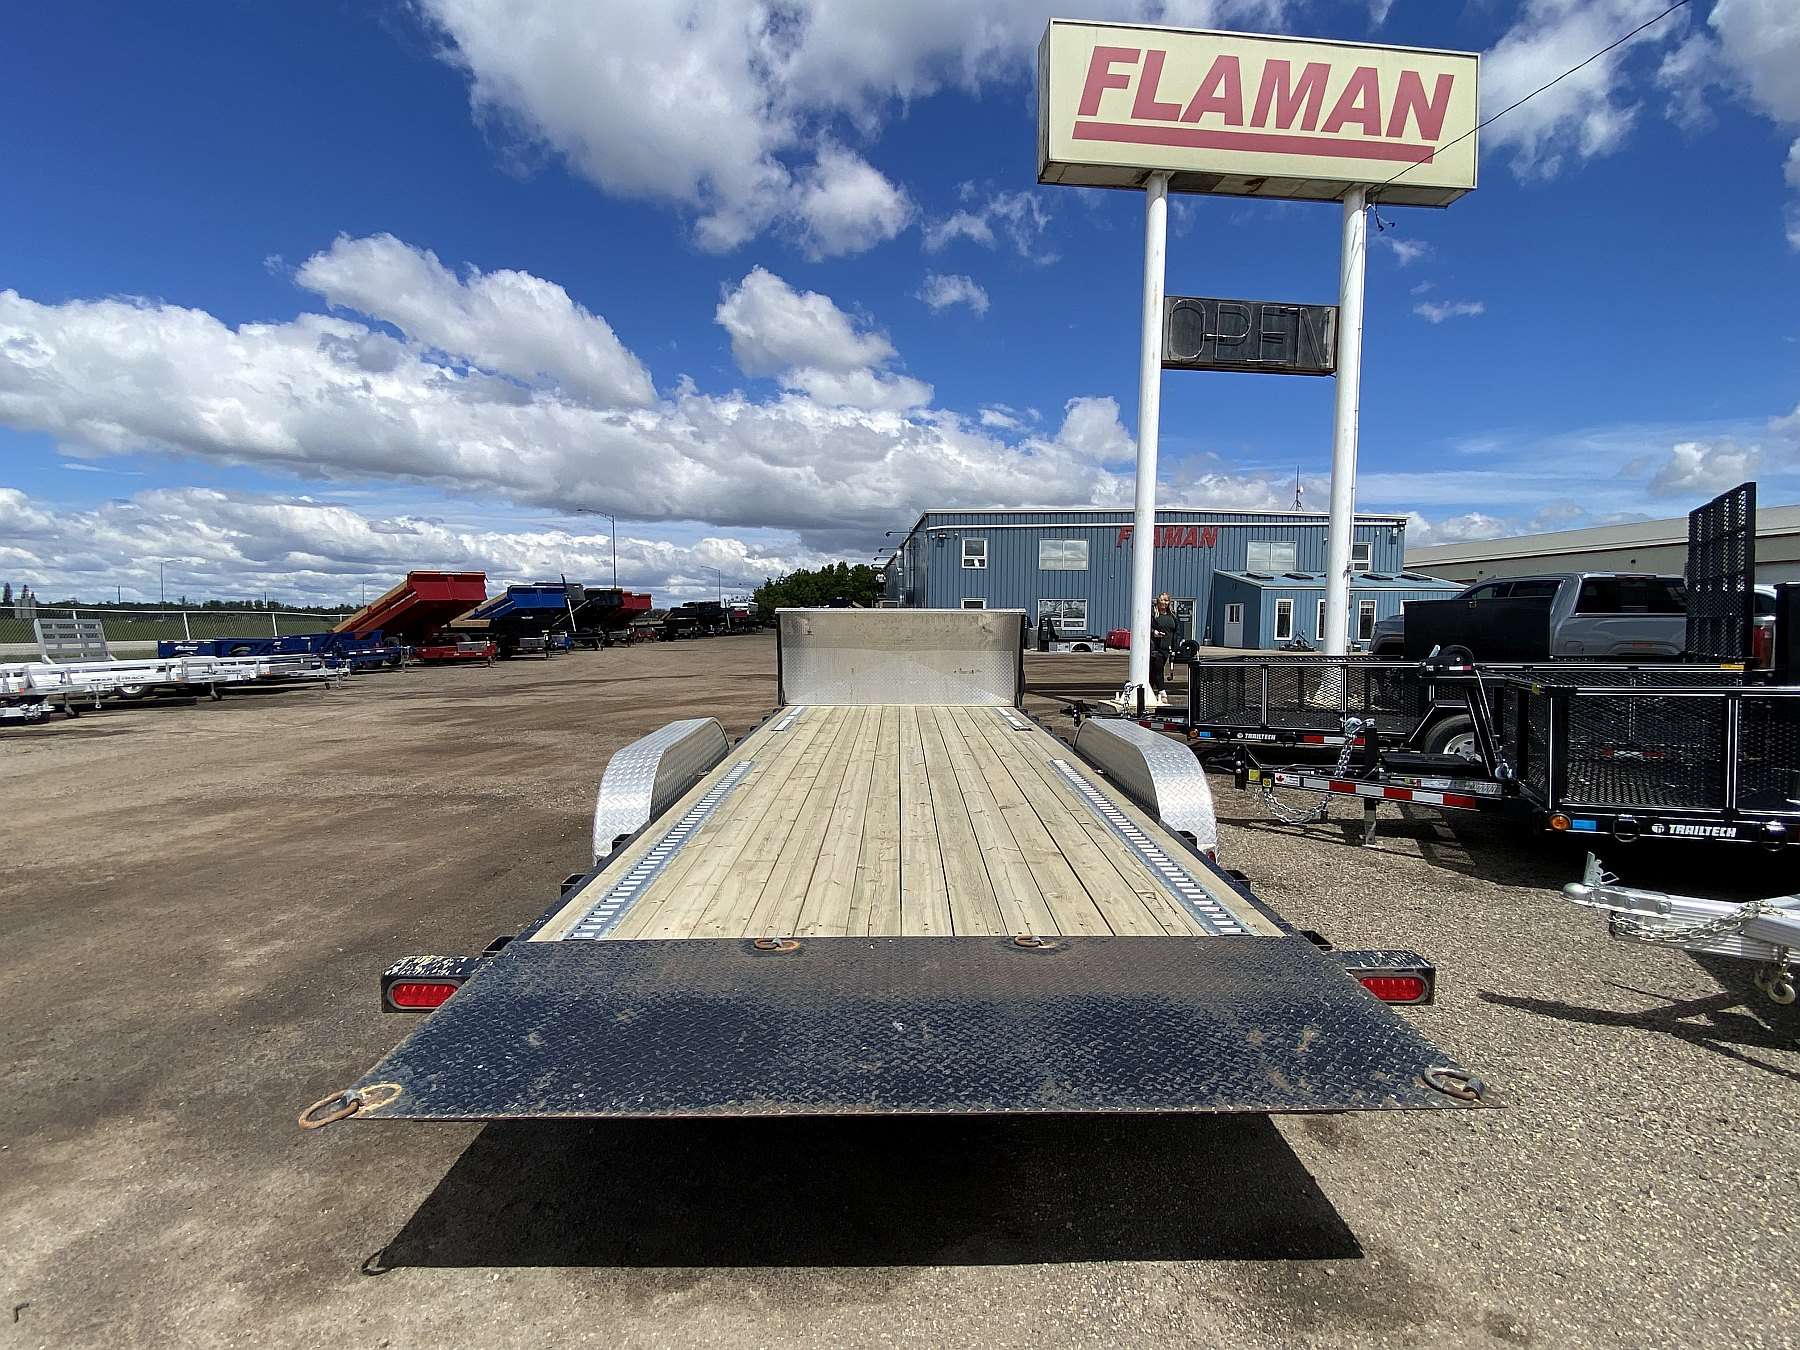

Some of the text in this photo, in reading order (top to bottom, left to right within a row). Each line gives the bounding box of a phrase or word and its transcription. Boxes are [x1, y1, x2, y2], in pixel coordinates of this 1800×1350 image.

[1077, 46, 1455, 141] FLAMAN
[1168, 299, 1336, 368] OPEN
[1116, 526, 1218, 548] FAMAN
[1669, 824, 1737, 837] TRAILTECH
